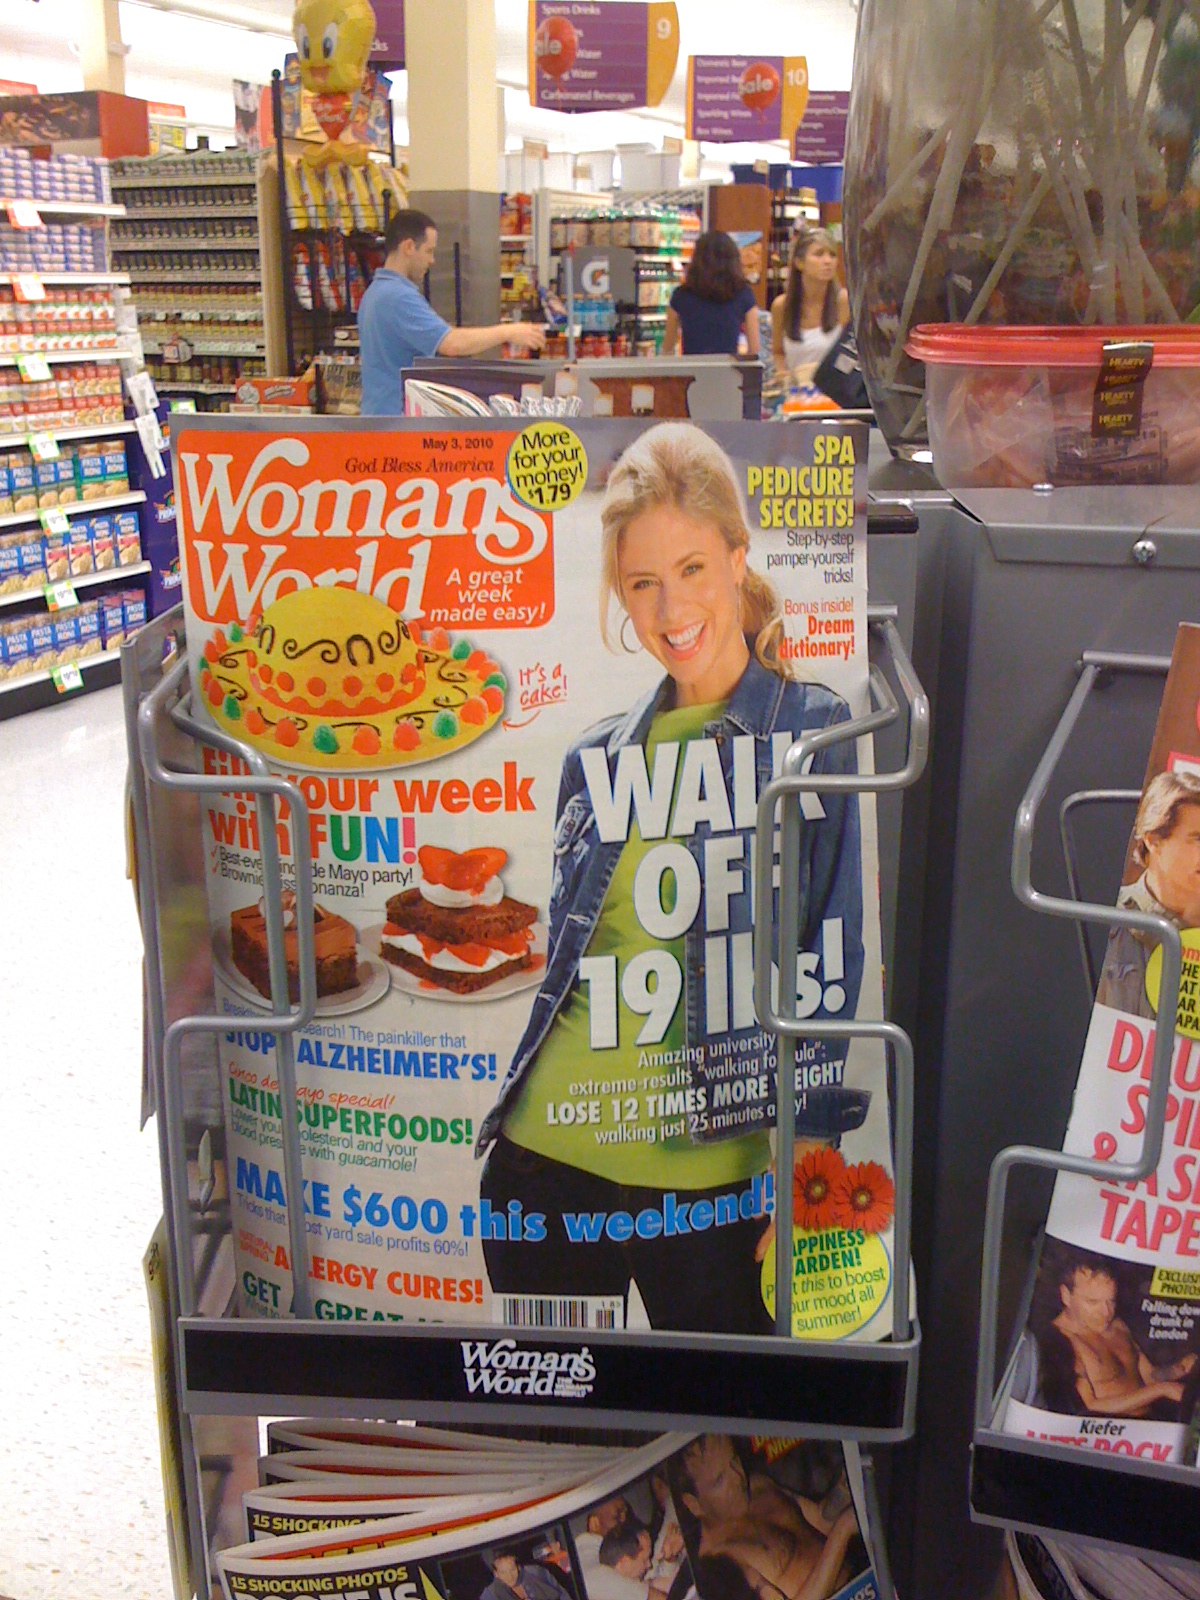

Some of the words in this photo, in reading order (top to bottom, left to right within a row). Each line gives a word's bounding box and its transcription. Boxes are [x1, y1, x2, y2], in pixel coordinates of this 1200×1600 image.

[534, 31, 562, 56] ale
[656, 19, 672, 39] 9
[787, 69, 806, 87] 10
[581, 257, 610, 294] G
[423, 438, 447, 450] May
[451, 438, 463, 450] 3,
[465, 438, 493, 449] 2010
[522, 430, 570, 450] More
[814, 435, 855, 465] SPA
[345, 457, 377, 474] God
[381, 456, 421, 473] Bless
[426, 456, 495, 473] America
[513, 451, 537, 469] for
[542, 447, 581, 470] your
[516, 461, 584, 489] money!
[747, 466, 854, 496] PEDICURE
[528, 484, 571, 505] $1.79
[760, 497, 854, 528] SECRETS!
[787, 530, 854, 547] Step-by-step
[767, 548, 854, 569] pamper-yourself
[446, 569, 461, 585] A
[468, 567, 523, 589] great
[824, 569, 853, 584] tricks!
[458, 585, 513, 603] week
[785, 600, 818, 615] Bonus
[821, 598, 854, 613] inside!
[430, 604, 487, 622] made
[493, 602, 545, 627] easy!
[808, 616, 854, 634] Dream
[779, 636, 855, 662] dictionary!
[518, 662, 546, 687] It's
[552, 664, 563, 678] a
[519, 674, 569, 706] cake!
[394, 761, 537, 814] week
[580, 728, 827, 845] WALK
[208, 801, 291, 856] with
[308, 813, 416, 865] FUN!
[219, 846, 265, 871] Best-eve
[330, 864, 369, 884] Mayo
[372, 866, 414, 887] party!
[578, 949, 684, 1050] 19
[297, 1022, 346, 1040] search!
[350, 1026, 374, 1043] The
[377, 1027, 436, 1048] painkiller
[439, 1032, 466, 1050] that
[638, 1044, 705, 1069] Amazing
[709, 1031, 776, 1059] university
[297, 1038, 498, 1082] ALZHEIMER'S!
[228, 1061, 258, 1084] Cinco
[261, 1074, 279, 1090] de
[295, 1085, 325, 1106] ayo
[328, 1093, 396, 1111] special!
[546, 1099, 602, 1126] LOSE
[611, 1097, 640, 1123] 12
[646, 1086, 708, 1120] TIMES
[713, 1074, 769, 1109] MORE
[774, 1061, 845, 1092] EIGHT
[228, 1077, 283, 1120] LATIN
[296, 1099, 473, 1146] SUPERFOODS!
[595, 1121, 657, 1146] walking
[660, 1117, 686, 1143] just
[691, 1112, 709, 1134] 25
[712, 1104, 764, 1130] minutes
[767, 1104, 776, 1117] a
[260, 1118, 283, 1135] you
[299, 1127, 353, 1149] olesterol
[357, 1137, 382, 1153] and
[386, 1143, 418, 1158] your
[260, 1132, 307, 1156] prese
[309, 1145, 335, 1161] with
[339, 1152, 417, 1173] guacamole!
[343, 1184, 448, 1235] $600
[459, 1196, 547, 1243] this
[562, 1170, 775, 1244] weekend!
[325, 1225, 353, 1242] yard
[356, 1231, 384, 1247] sale
[387, 1235, 431, 1254] profits
[434, 1239, 469, 1257] 60%!
[792, 1228, 866, 1257] PPINESS
[274, 1244, 378, 1291] AERGY
[387, 1271, 484, 1305] CURES!
[795, 1248, 862, 1277] ARDEN!
[243, 1271, 281, 1308] GET
[801, 1276, 825, 1294] this
[827, 1275, 842, 1289] to
[845, 1266, 886, 1286] boost
[791, 1298, 810, 1314] our
[813, 1288, 857, 1310] mood
[860, 1285, 876, 1302] all
[797, 1305, 862, 1332] summer!
[1149, 1327, 1188, 1340] London
[460, 1338, 597, 1382] Woman's
[463, 1367, 557, 1396] World
[1079, 1419, 1126, 1436] Kiefer
[253, 1513, 270, 1528] 15
[231, 1575, 247, 1590] 15
[249, 1576, 334, 1593] SHOCKING
[336, 1566, 408, 1590] PHOTOS
